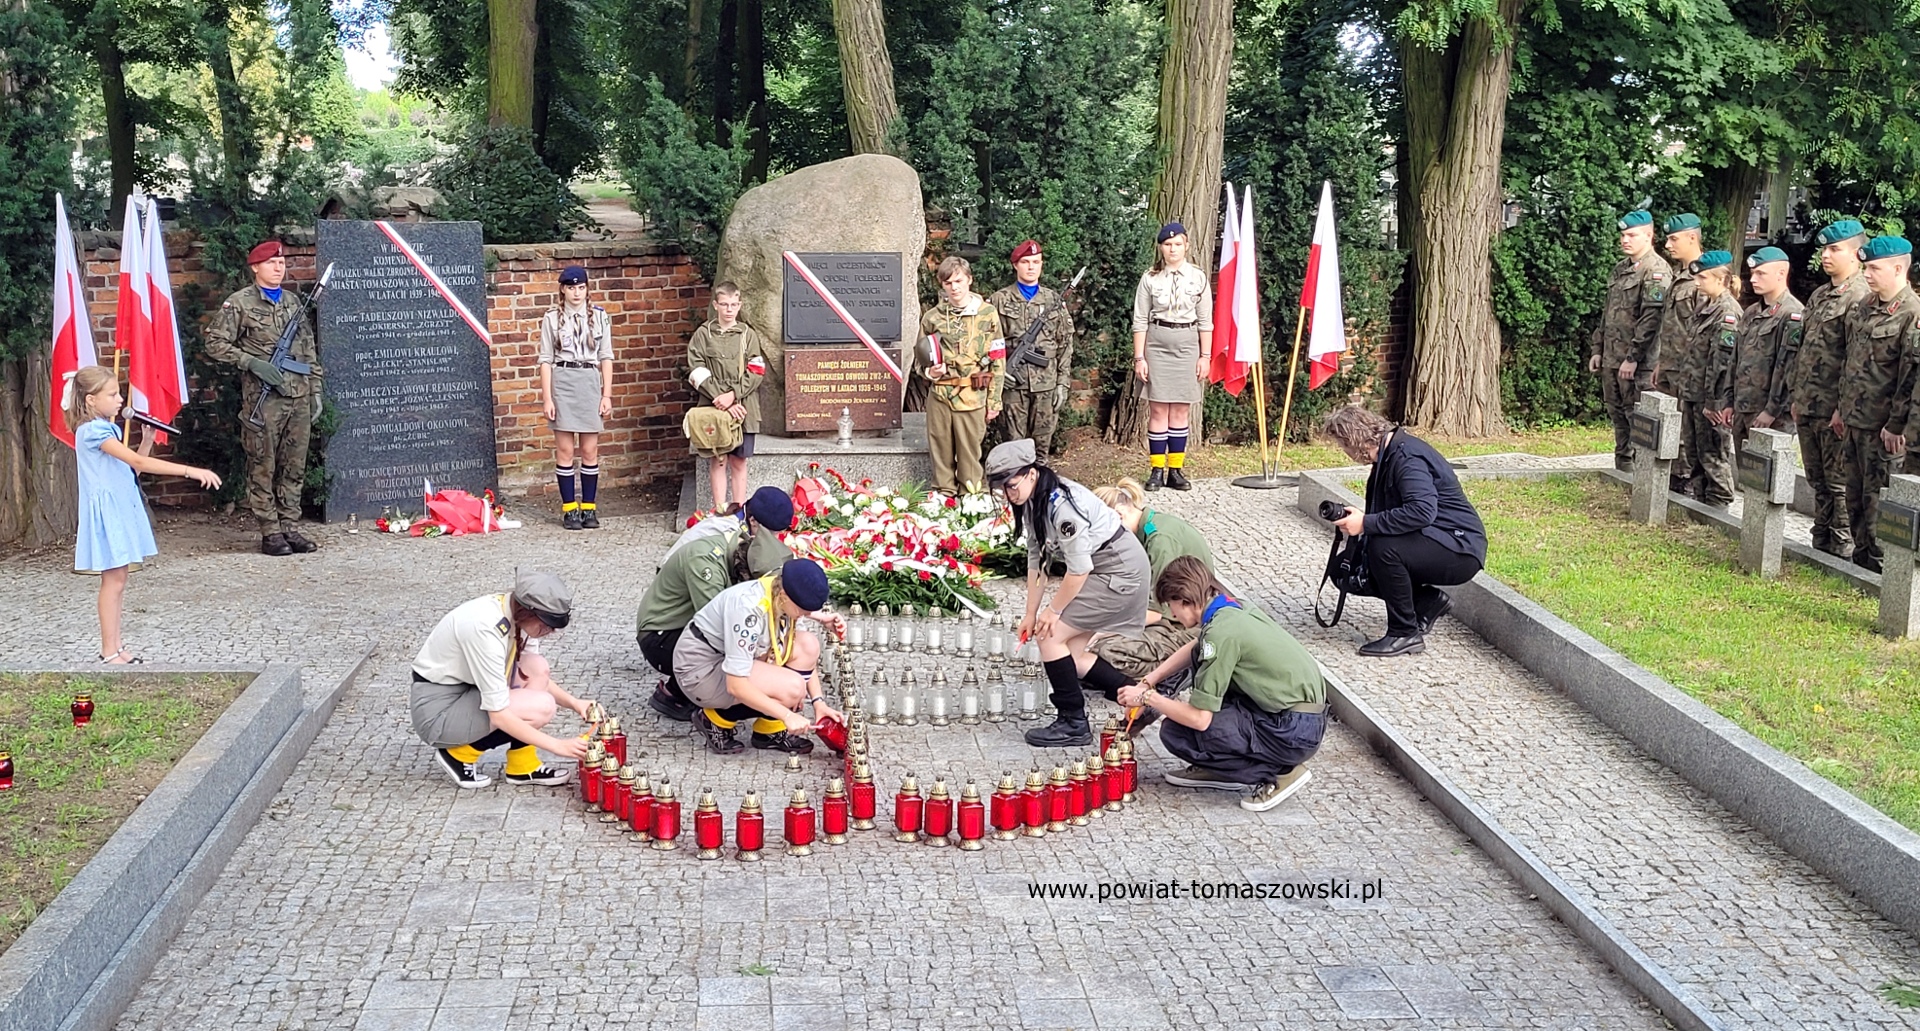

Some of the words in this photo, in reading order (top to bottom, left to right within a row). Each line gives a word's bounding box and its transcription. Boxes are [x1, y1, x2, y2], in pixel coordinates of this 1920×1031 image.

[380, 244, 388, 252] W
[441, 264, 474, 274] KRAJOWEJ
[330, 280, 360, 290] MIASTA
[362, 278, 410, 288] TOMASZOWA
[410, 290, 422, 299] 1939
[336, 314, 358, 325] pchor.
[360, 310, 414, 322] TADEUSZOWI
[374, 348, 412, 359] EMILOWI
[817, 361, 839, 370] PAMIĘCI
[840, 360, 869, 369] ŻOŁNIERZY
[795, 372, 844, 381] TOMASZOWSKIEGO
[837, 384, 857, 392] LATACH
[371, 421, 424, 434] ROMUALDOWI
